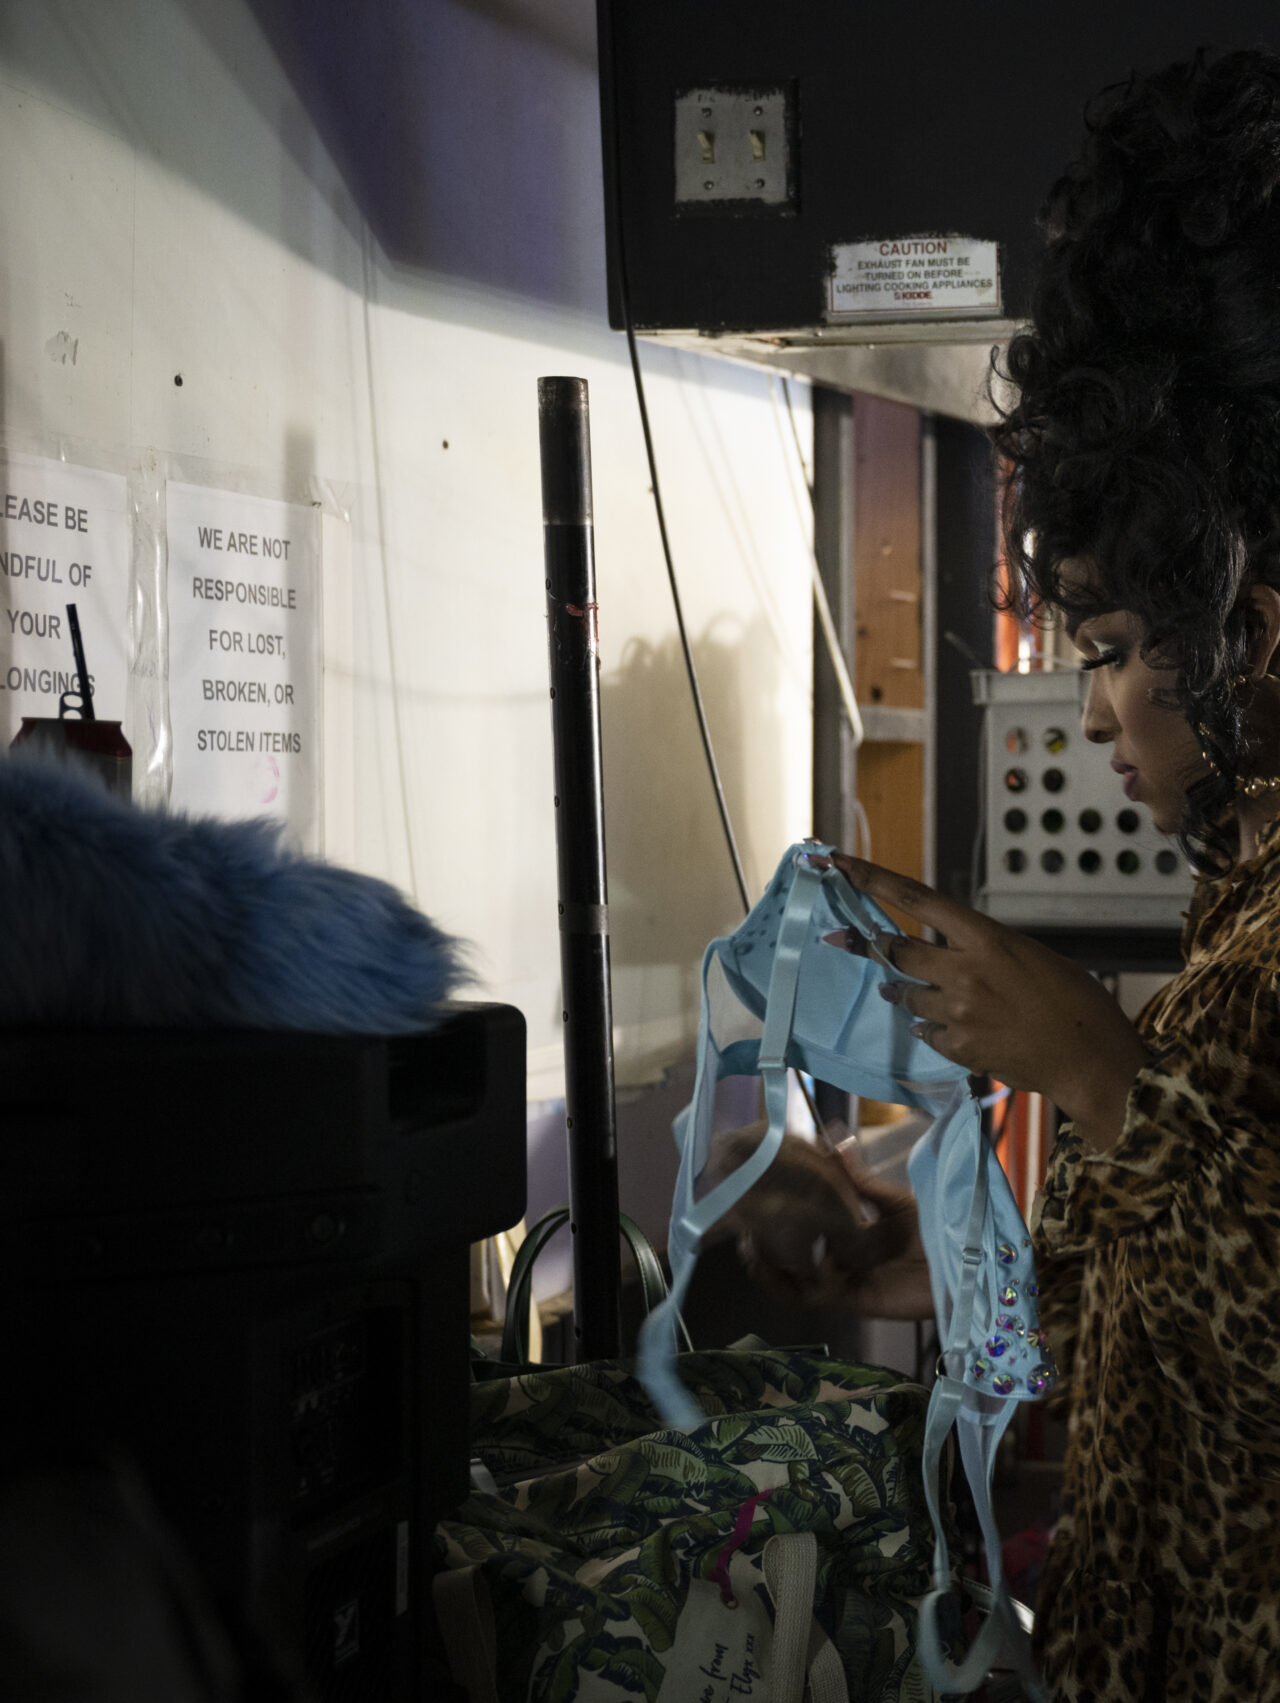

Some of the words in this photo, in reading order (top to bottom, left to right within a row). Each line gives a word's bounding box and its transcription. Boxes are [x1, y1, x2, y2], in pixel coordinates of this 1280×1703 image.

[880, 241, 947, 256] CAUTION
[857, 260, 902, 270] EXHAUST
[906, 259, 924, 268] FAN
[928, 257, 954, 267] MUST
[957, 256, 970, 266] BE
[866, 270, 904, 281] TURNED
[907, 270, 921, 280] ON
[924, 268, 963, 278] BEFORE
[837, 283, 881, 293] LIGHTING
[884, 281, 929, 291] COOKING
[932, 278, 993, 289] APPLIANCES
[0, 494, 58, 527] EASE
[65, 506, 88, 533] BE
[198, 526, 223, 551] WE
[227, 531, 258, 555] ARE
[262, 536, 291, 560] NOT
[69, 562, 92, 588] OF
[192, 577, 297, 610] RESPONSIBLE
[6, 608, 61, 640] YOUR
[209, 630, 243, 654] FOR
[248, 634, 286, 659] LOST,
[0, 666, 95, 698] ONGINGS
[202, 679, 271, 706] BROKEN,
[274, 684, 295, 705] OR
[197, 730, 256, 753] STOLEN
[259, 732, 302, 754] ITEMS
